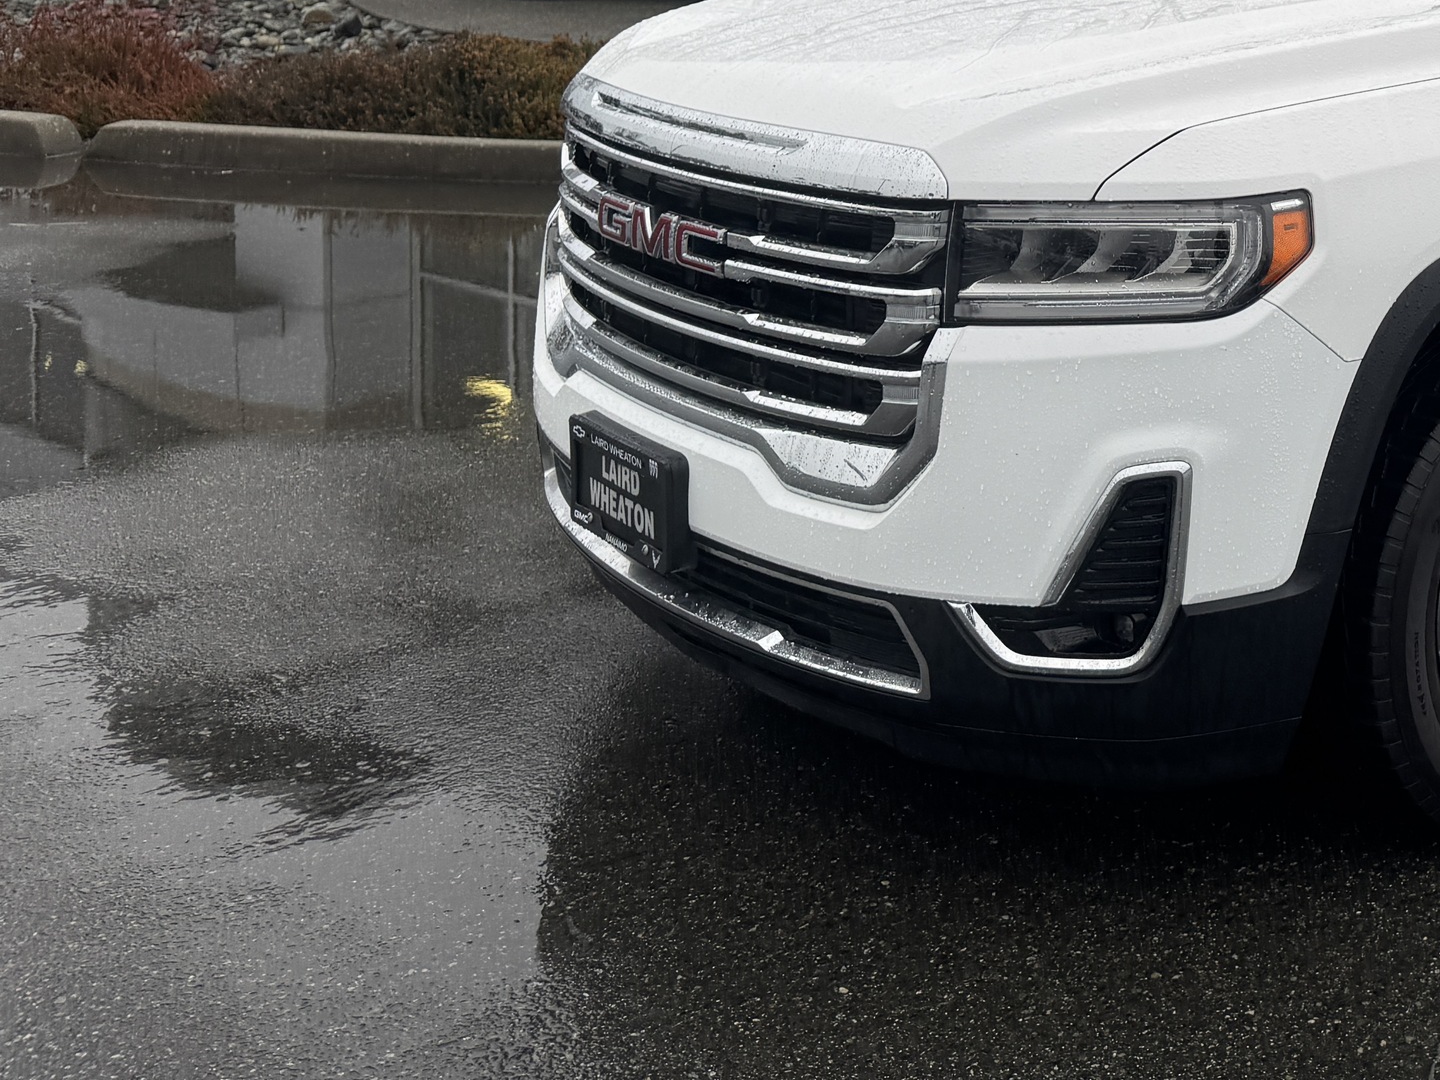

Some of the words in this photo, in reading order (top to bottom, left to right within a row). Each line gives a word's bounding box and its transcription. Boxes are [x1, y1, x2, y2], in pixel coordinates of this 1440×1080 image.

[598, 192, 728, 279] GMC
[590, 433, 609, 452] LAIRD
[609, 444, 643, 470] WHEATON
[601, 455, 640, 497] LAIRD
[589, 477, 655, 541] WHEATON
